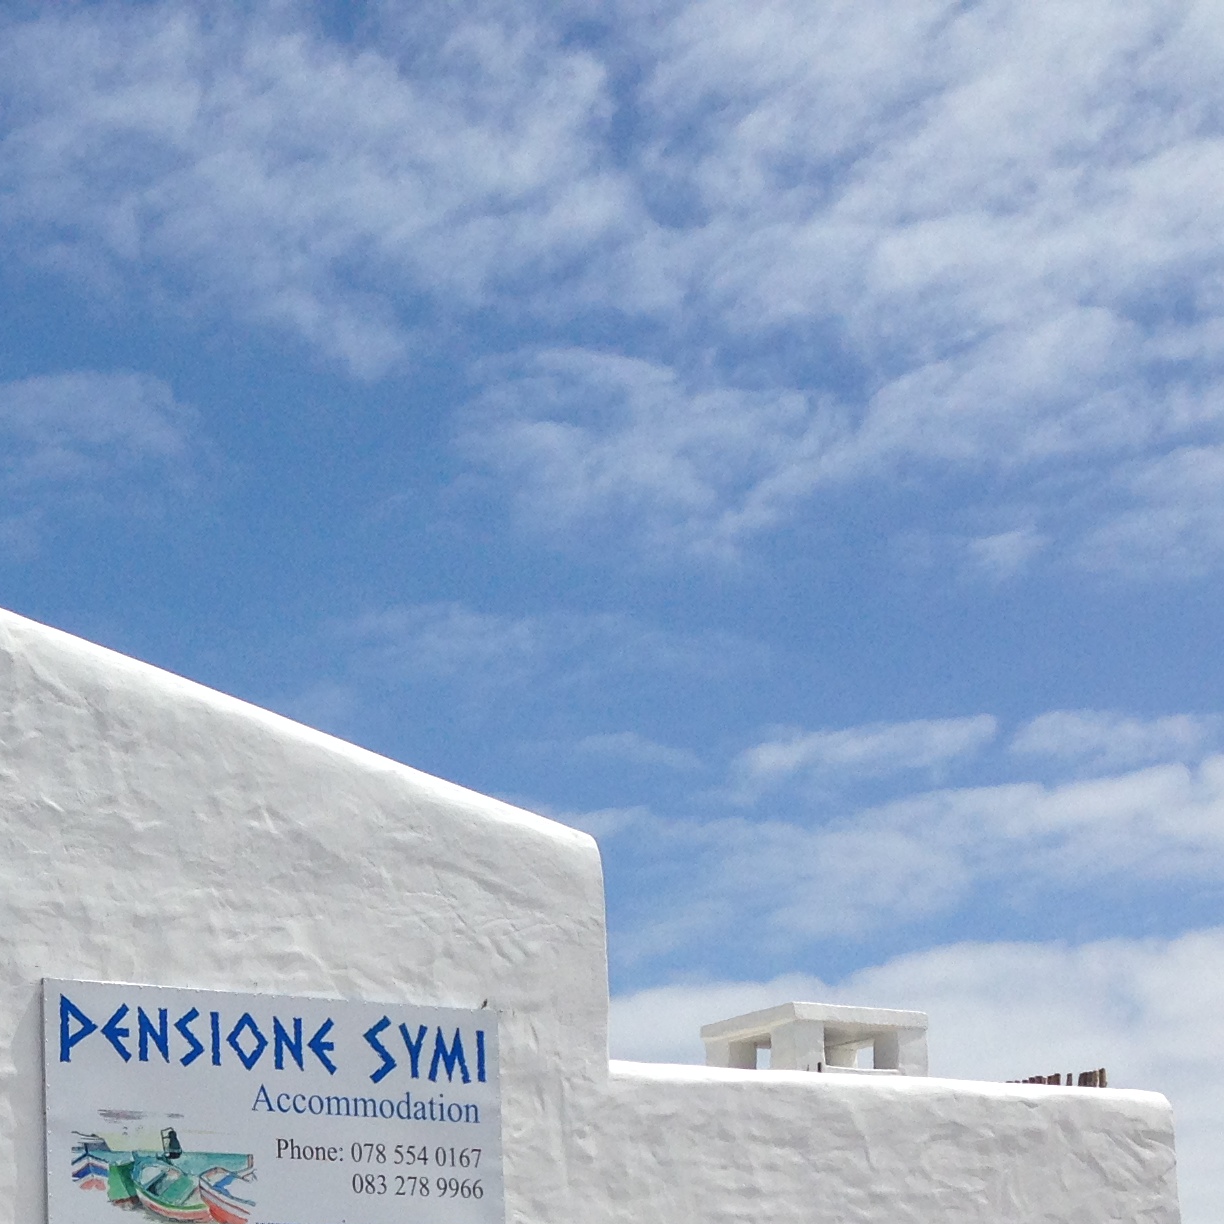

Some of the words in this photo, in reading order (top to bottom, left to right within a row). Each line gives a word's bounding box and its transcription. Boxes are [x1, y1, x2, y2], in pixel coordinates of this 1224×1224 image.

[59, 994, 337, 1075] PENSIONE
[364, 1016, 487, 1084] SYMI
[252, 1084, 480, 1123] Accommodation
[276, 1139, 344, 1162] Phone:
[351, 1143, 385, 1164] 078
[394, 1145, 428, 1166] 554
[435, 1148, 482, 1168] 0167
[352, 1174, 387, 1195] 083
[396, 1176, 429, 1197] 278
[436, 1178, 483, 1199] 9966
